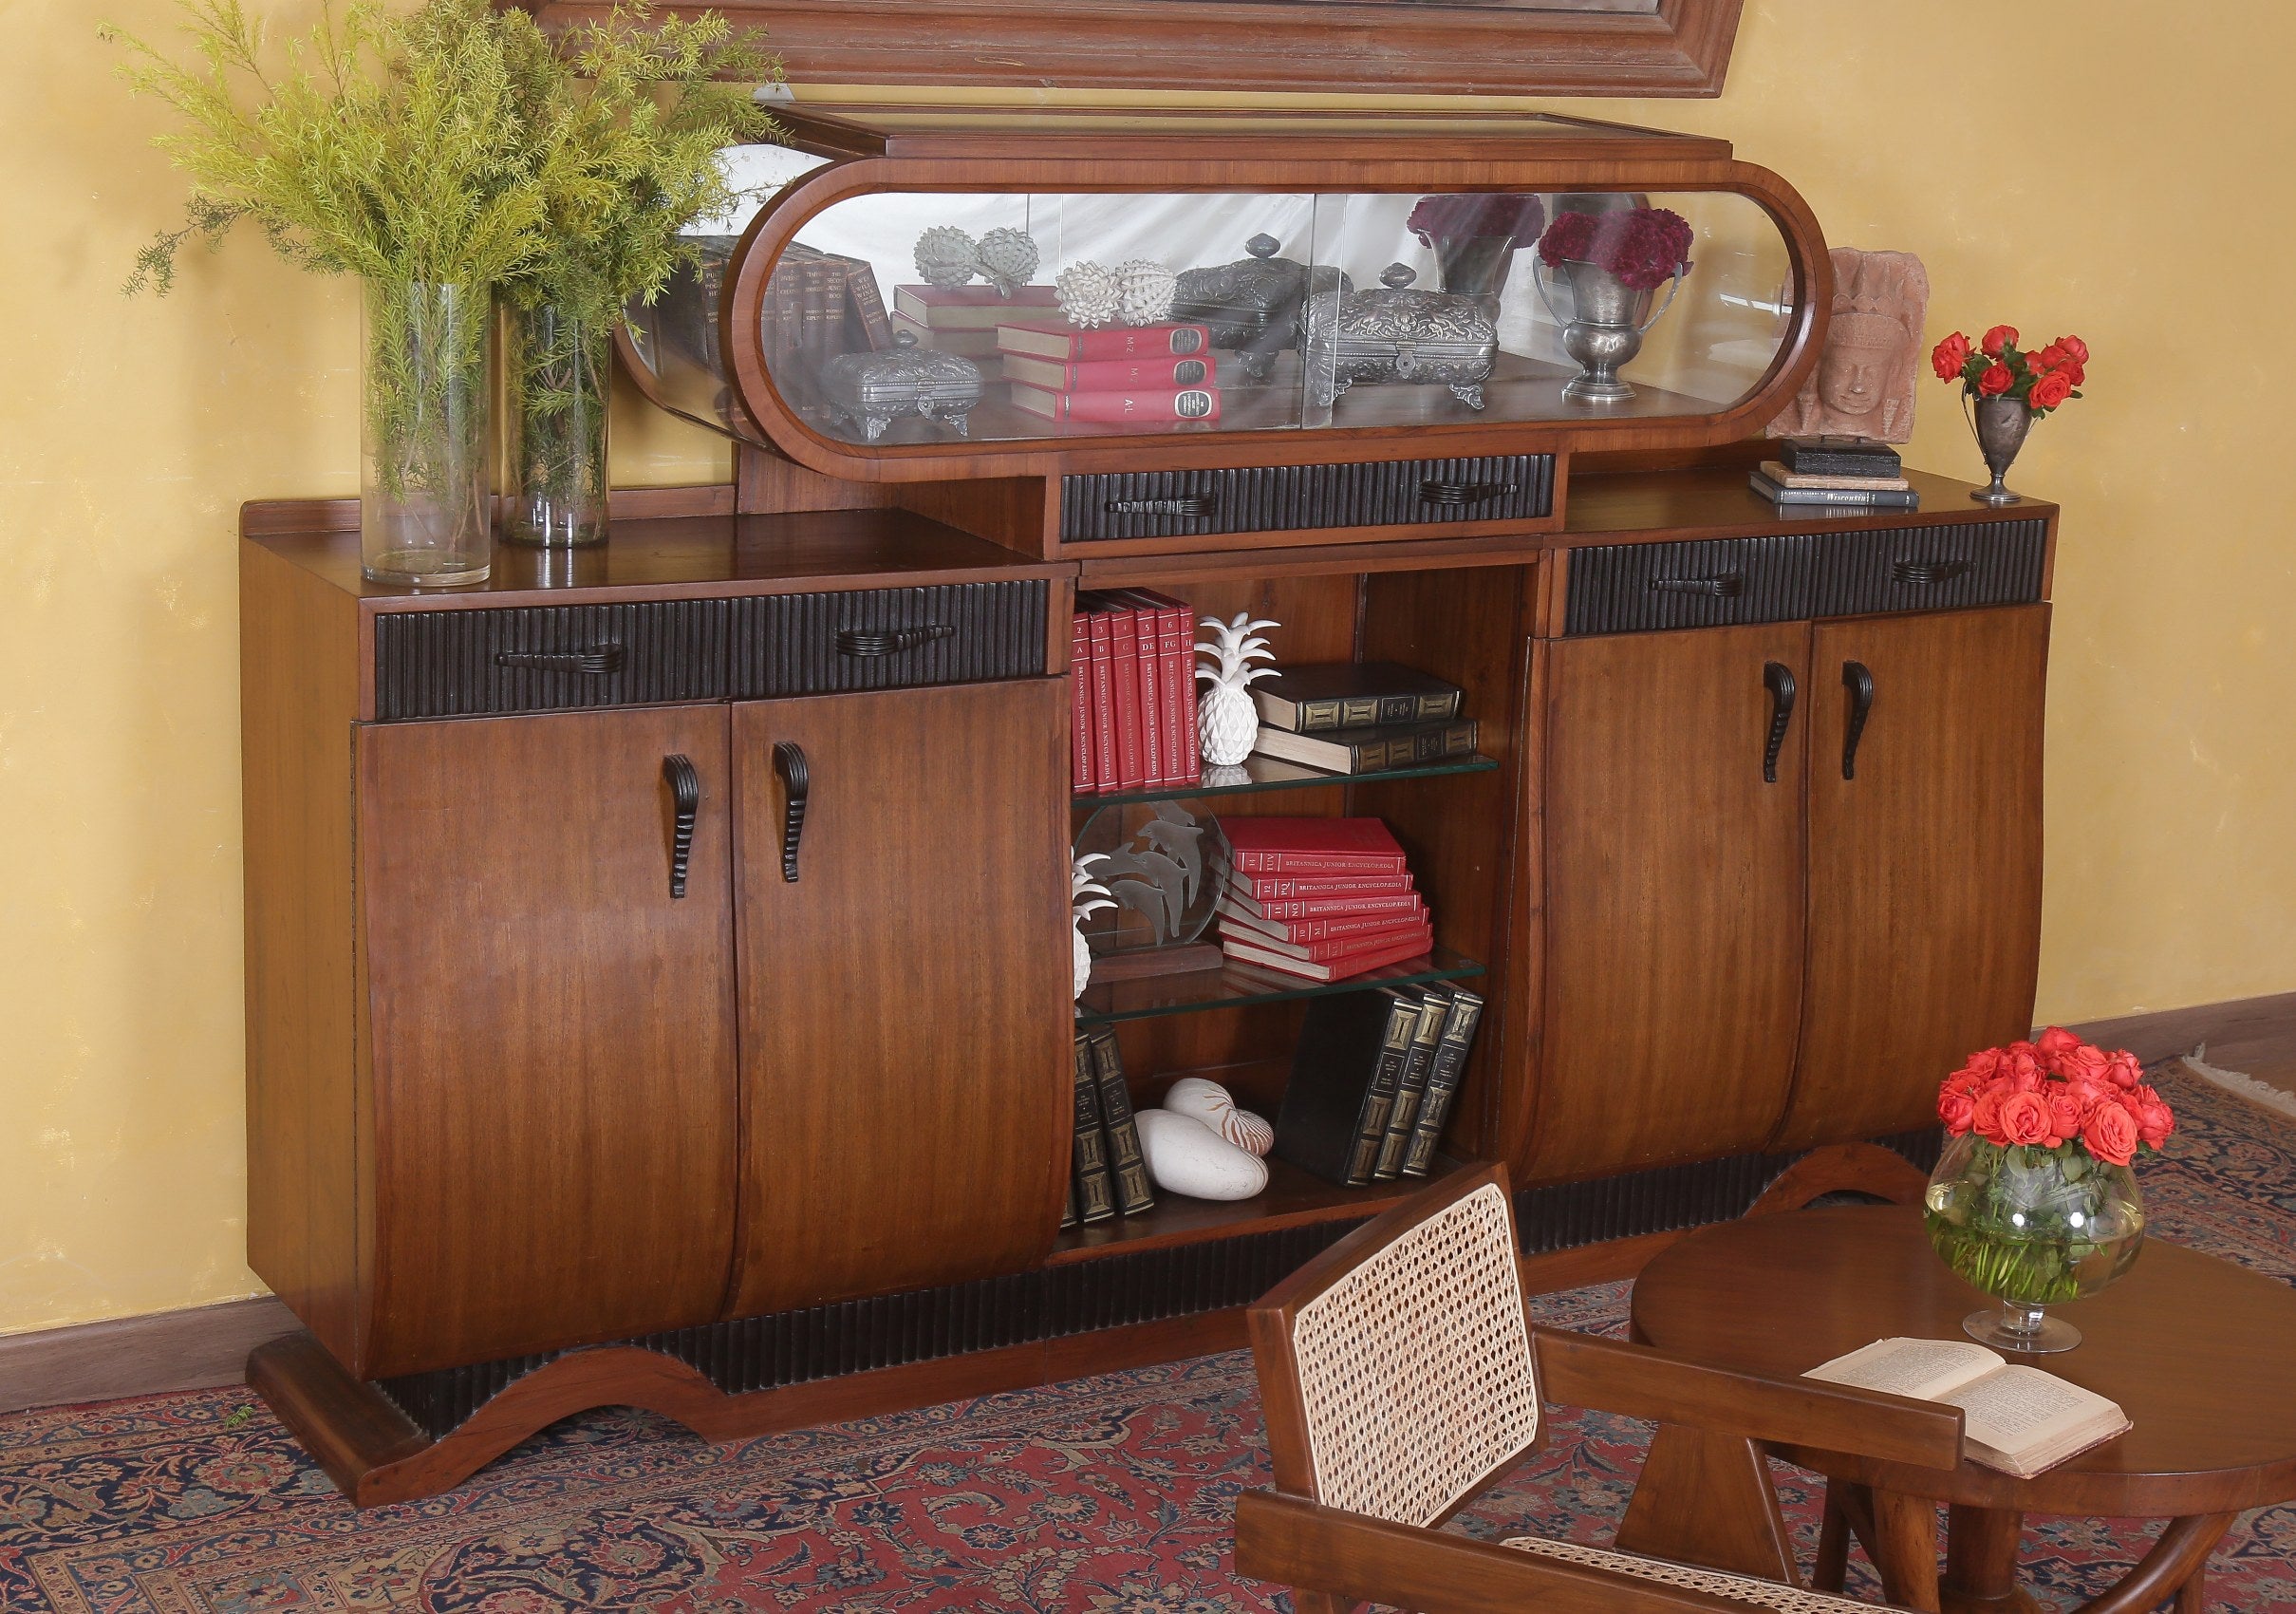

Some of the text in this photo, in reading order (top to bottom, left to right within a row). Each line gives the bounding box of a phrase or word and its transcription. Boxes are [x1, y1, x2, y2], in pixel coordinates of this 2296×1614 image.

[1826, 492, 1867, 502] Wisconsin
[1142, 642, 1155, 651] DE
[1165, 640, 1176, 648] FG
[1146, 663, 1154, 702] BRITANNICA
[1147, 702, 1155, 726] JUNIOR
[1263, 884, 1271, 893] 12
[1280, 881, 1291, 895] PQ
[1291, 903, 1299, 917] NO
[1344, 903, 1367, 911] JUNIOR
[1330, 923, 1361, 932] BRITANNICA
[1360, 921, 1381, 929] JUNIOR
[1298, 929, 1306, 938] 10
